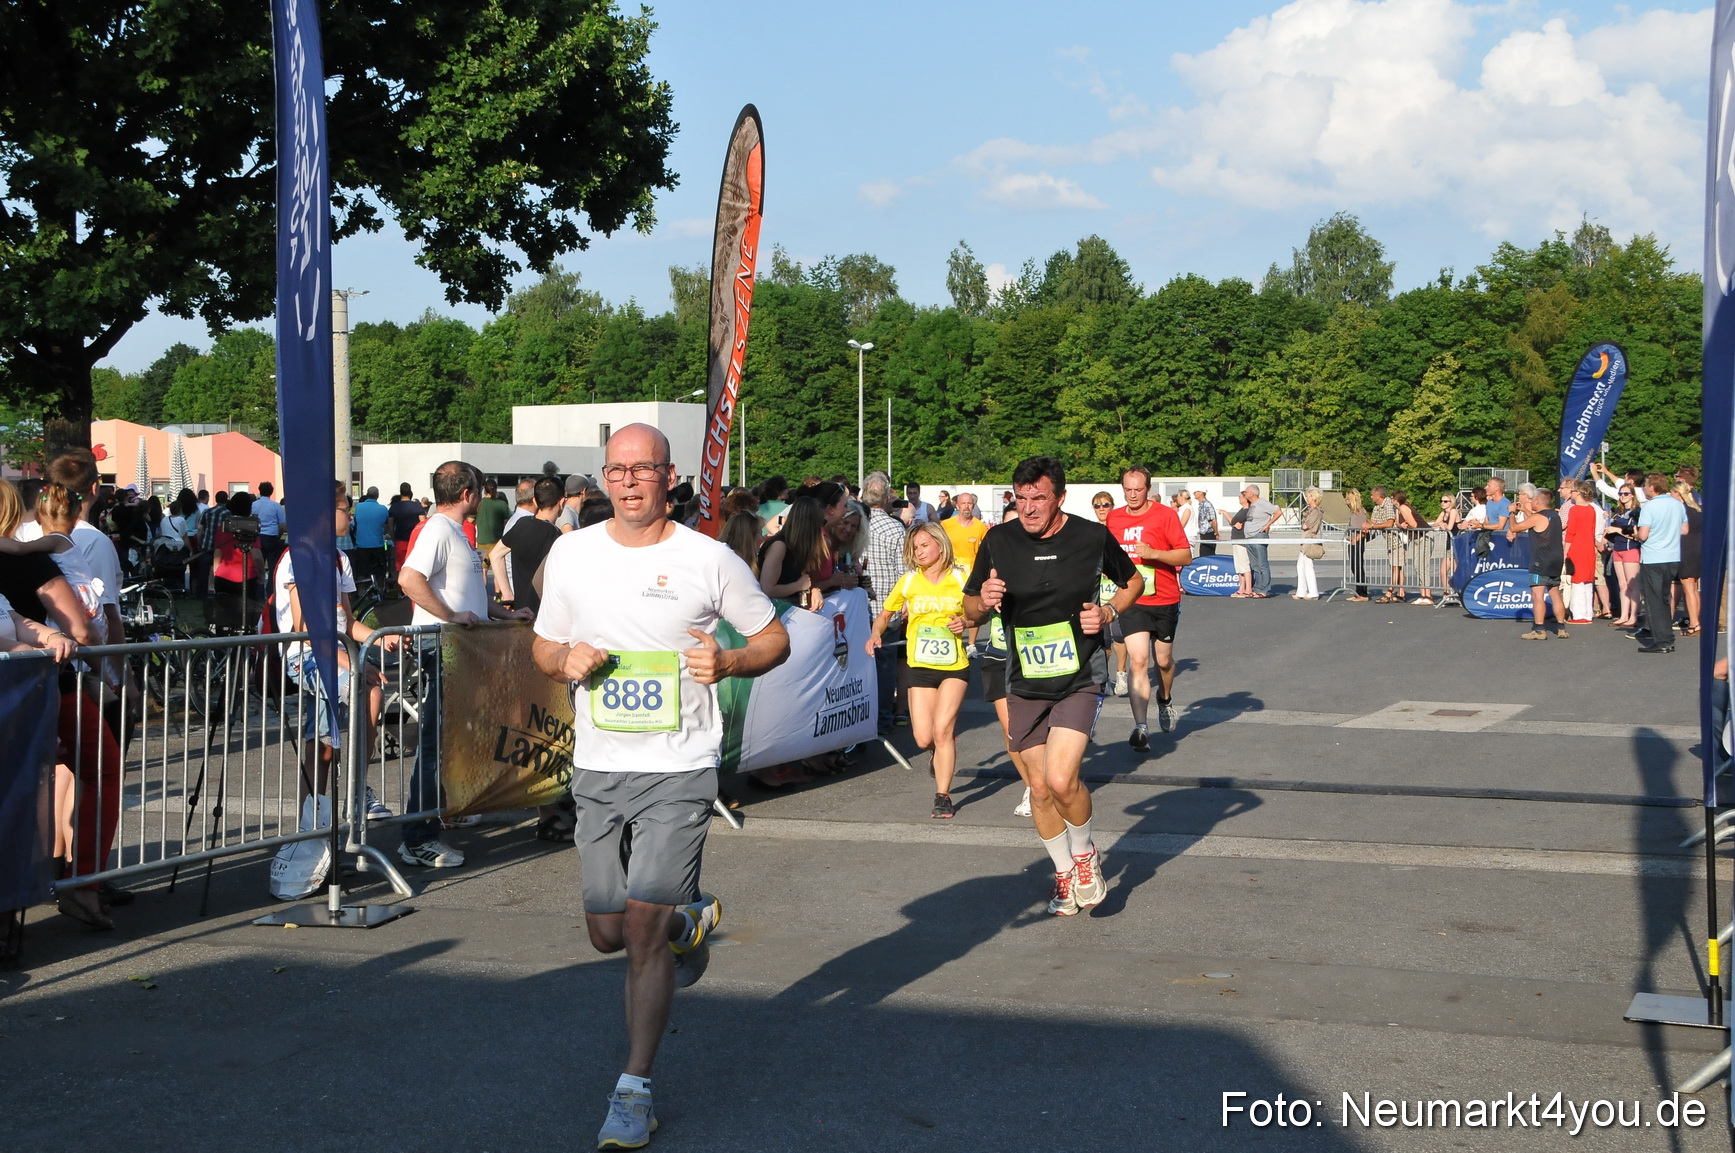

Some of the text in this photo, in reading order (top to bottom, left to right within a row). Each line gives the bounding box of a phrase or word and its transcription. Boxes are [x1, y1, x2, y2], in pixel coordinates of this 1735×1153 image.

[1564, 381, 1606, 459] Frischmann
[913, 601, 944, 614] RUN
[1488, 591, 1549, 603] Fischr
[920, 639, 950, 655] 733
[1021, 640, 1075, 665] 1074
[602, 678, 663, 711] 888
[825, 677, 863, 706] Neumarkter
[813, 697, 870, 738] Lammsbräu
